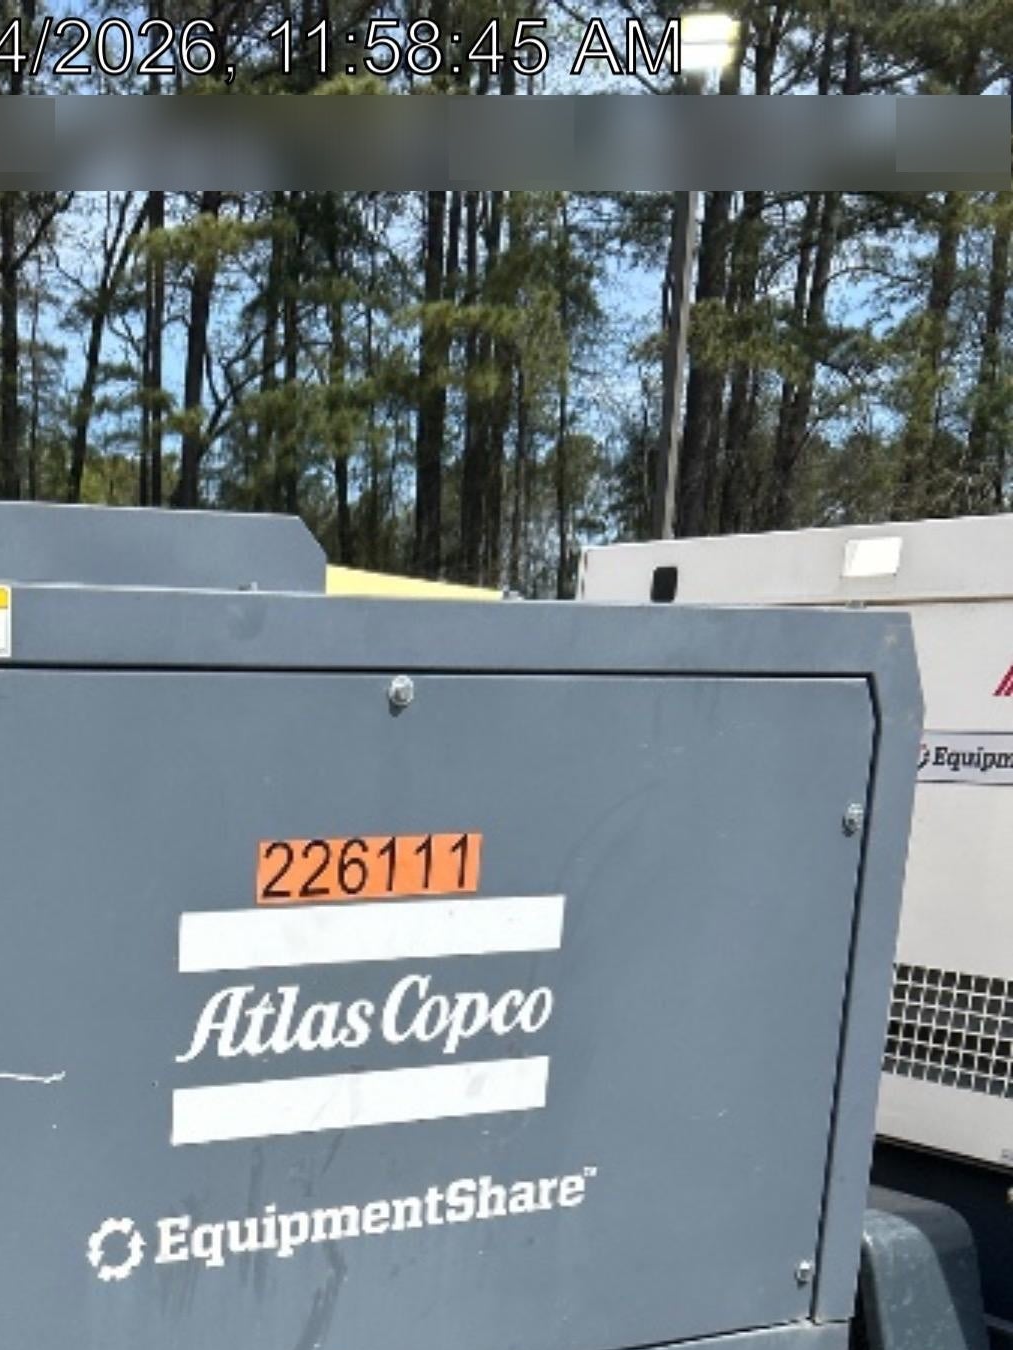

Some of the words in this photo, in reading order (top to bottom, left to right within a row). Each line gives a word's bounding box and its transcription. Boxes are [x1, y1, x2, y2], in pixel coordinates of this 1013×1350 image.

[261, 833, 470, 899] 226111
[175, 984, 376, 1063] Atlas
[381, 973, 555, 1055] Copco
